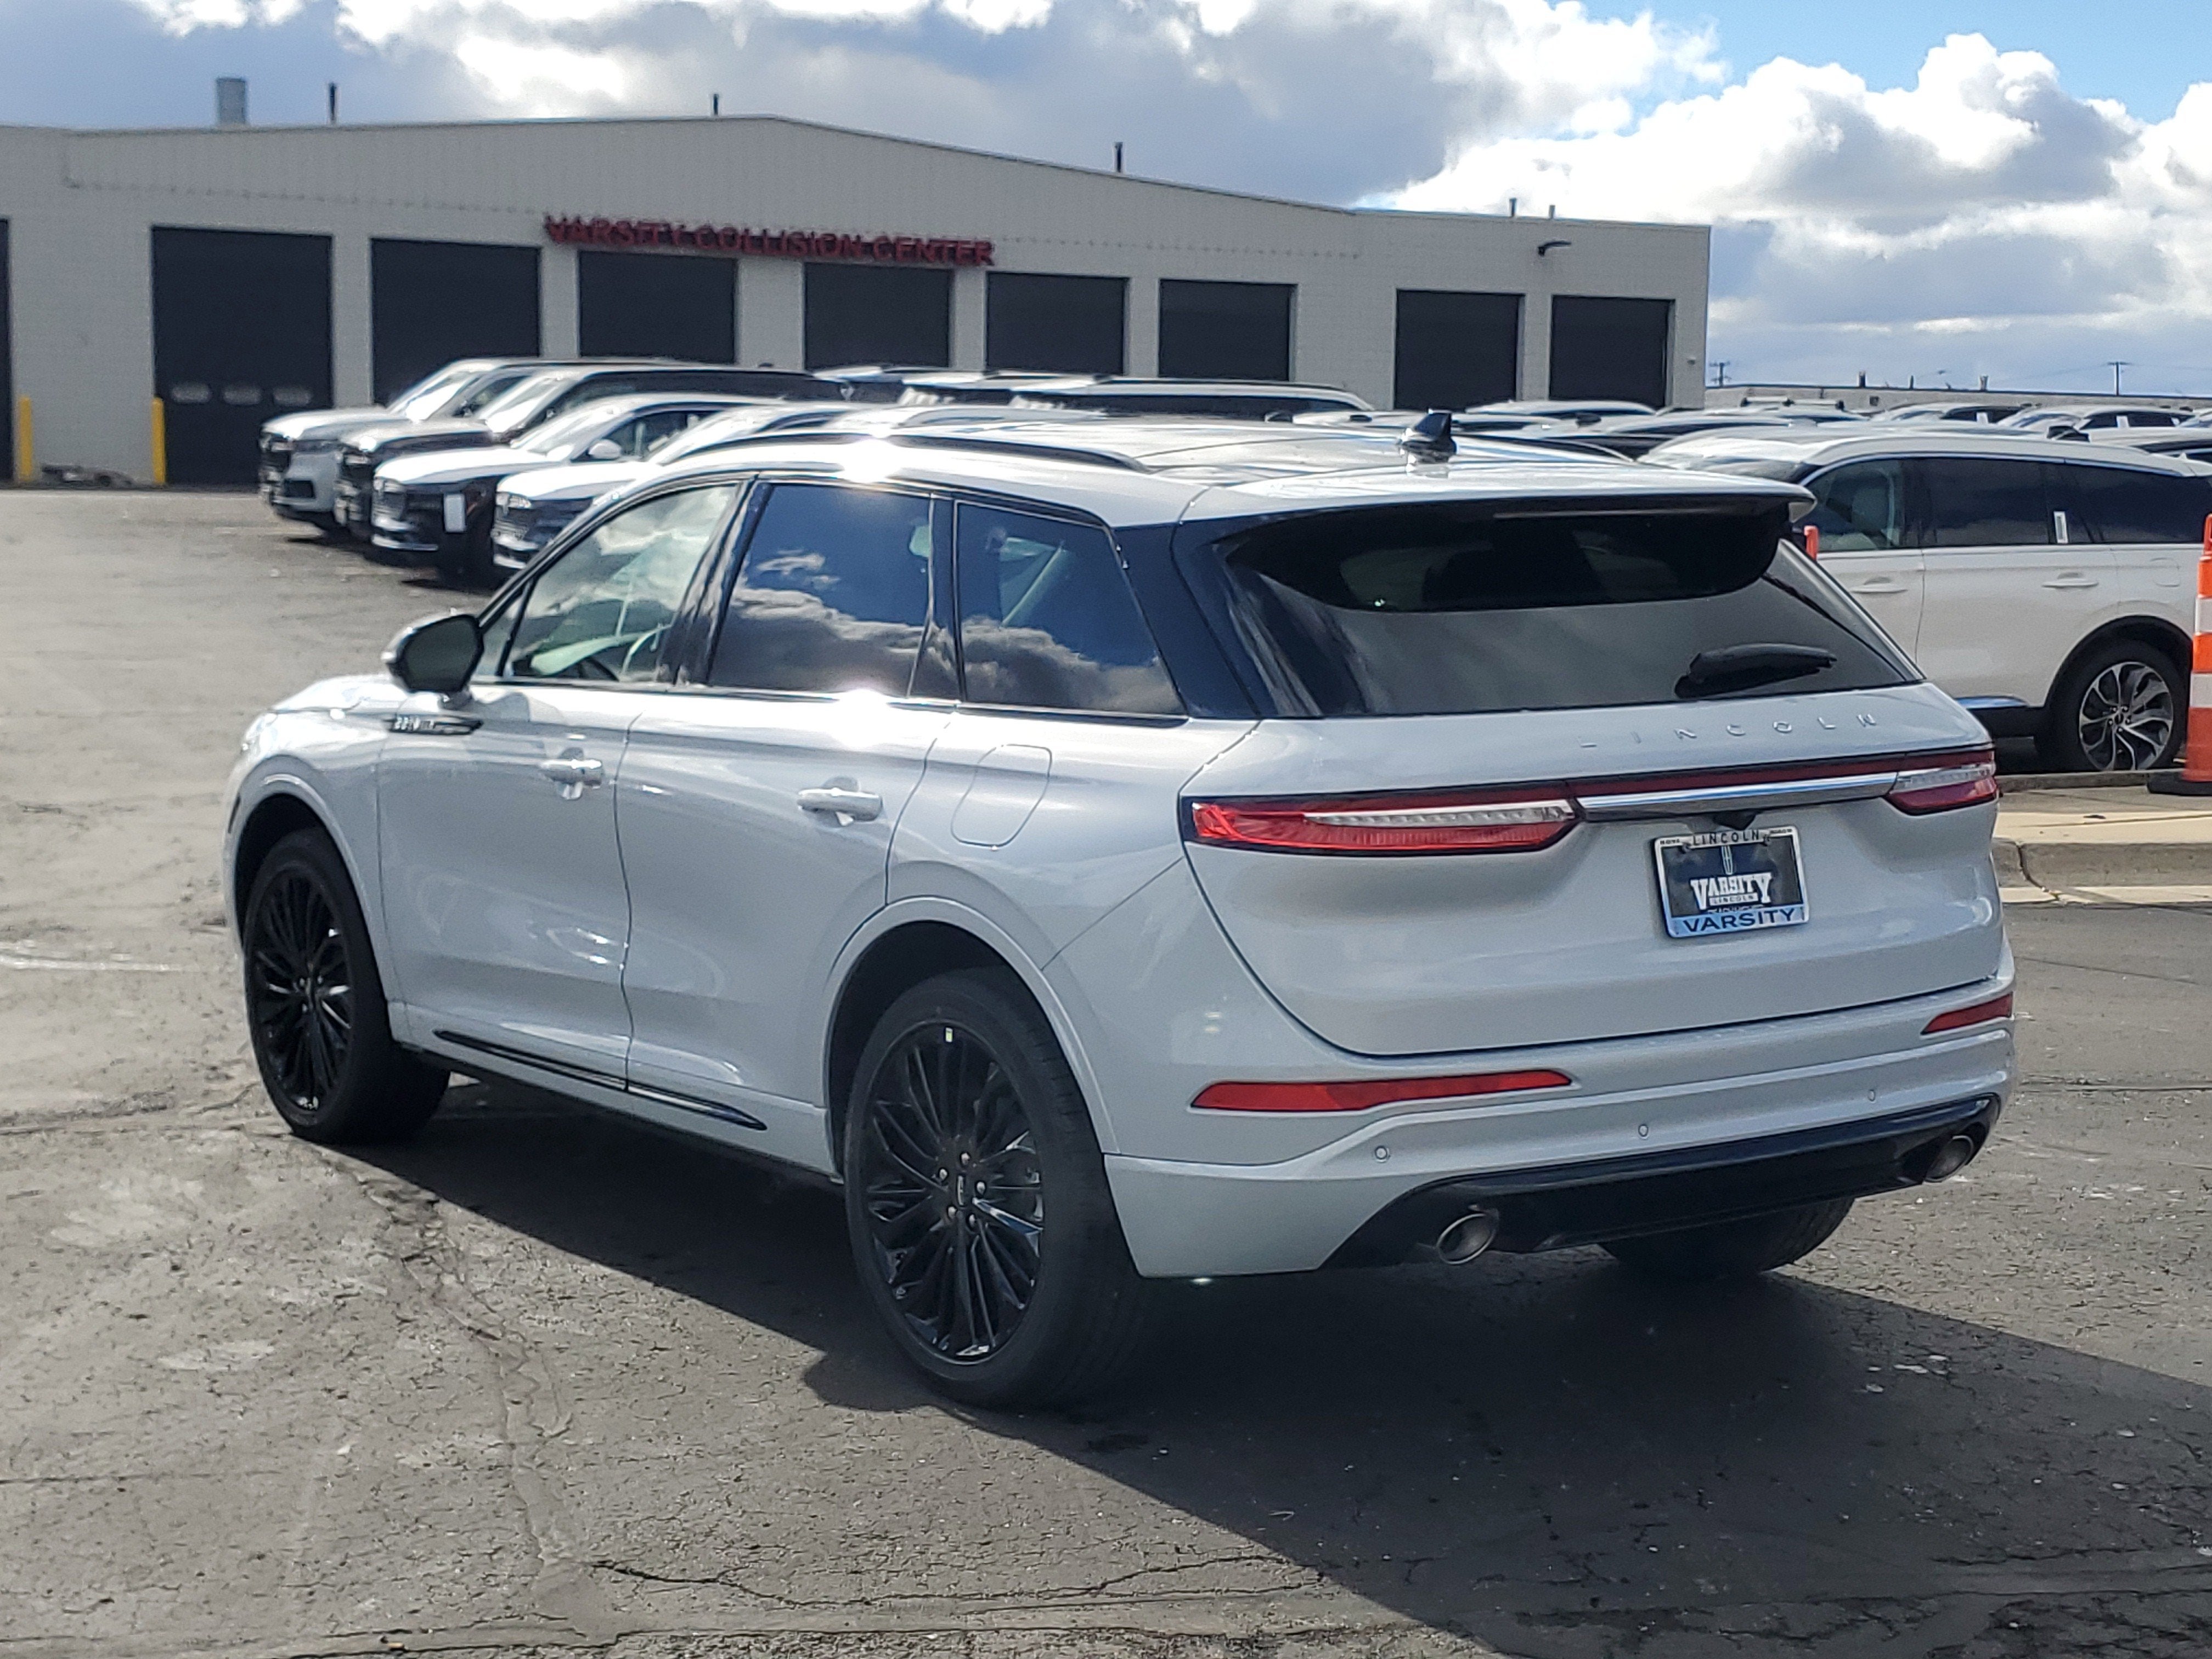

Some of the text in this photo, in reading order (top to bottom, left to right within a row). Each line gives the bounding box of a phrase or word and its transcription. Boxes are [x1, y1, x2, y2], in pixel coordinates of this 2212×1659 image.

[544, 215, 995, 266] VARSITY COLLISION CENTER
[1578, 713, 1876, 748] LINCOLN
[1692, 830, 1759, 846] LINCOLN
[1690, 872, 1772, 910] VARSITY
[1683, 907, 1795, 932] VARSITY
